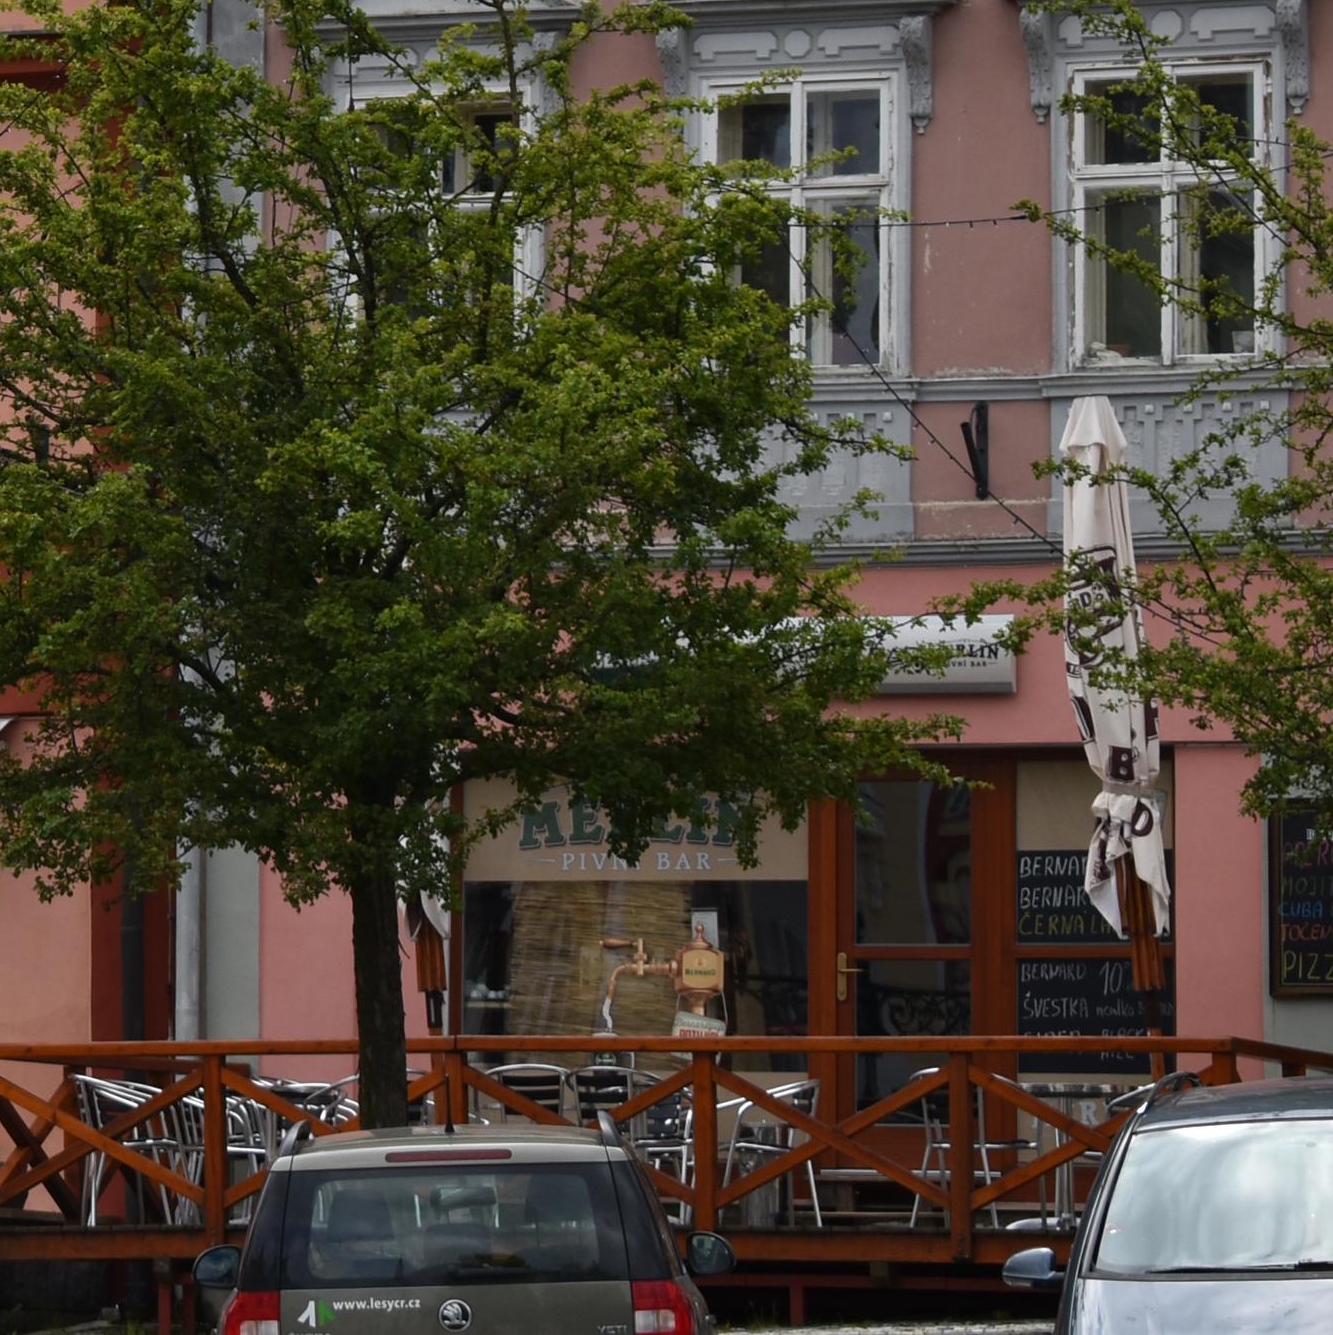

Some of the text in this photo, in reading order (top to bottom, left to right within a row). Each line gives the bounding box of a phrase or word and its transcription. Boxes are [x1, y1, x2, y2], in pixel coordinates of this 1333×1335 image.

[562, 852, 712, 871] PIVN BAR
[1280, 899, 1324, 918] CUBA
[1021, 963, 1086, 982] BERNARD
[1023, 991, 1089, 1019] ŠVESTKA
[333, 1297, 421, 1311] www.lesycr.cz
